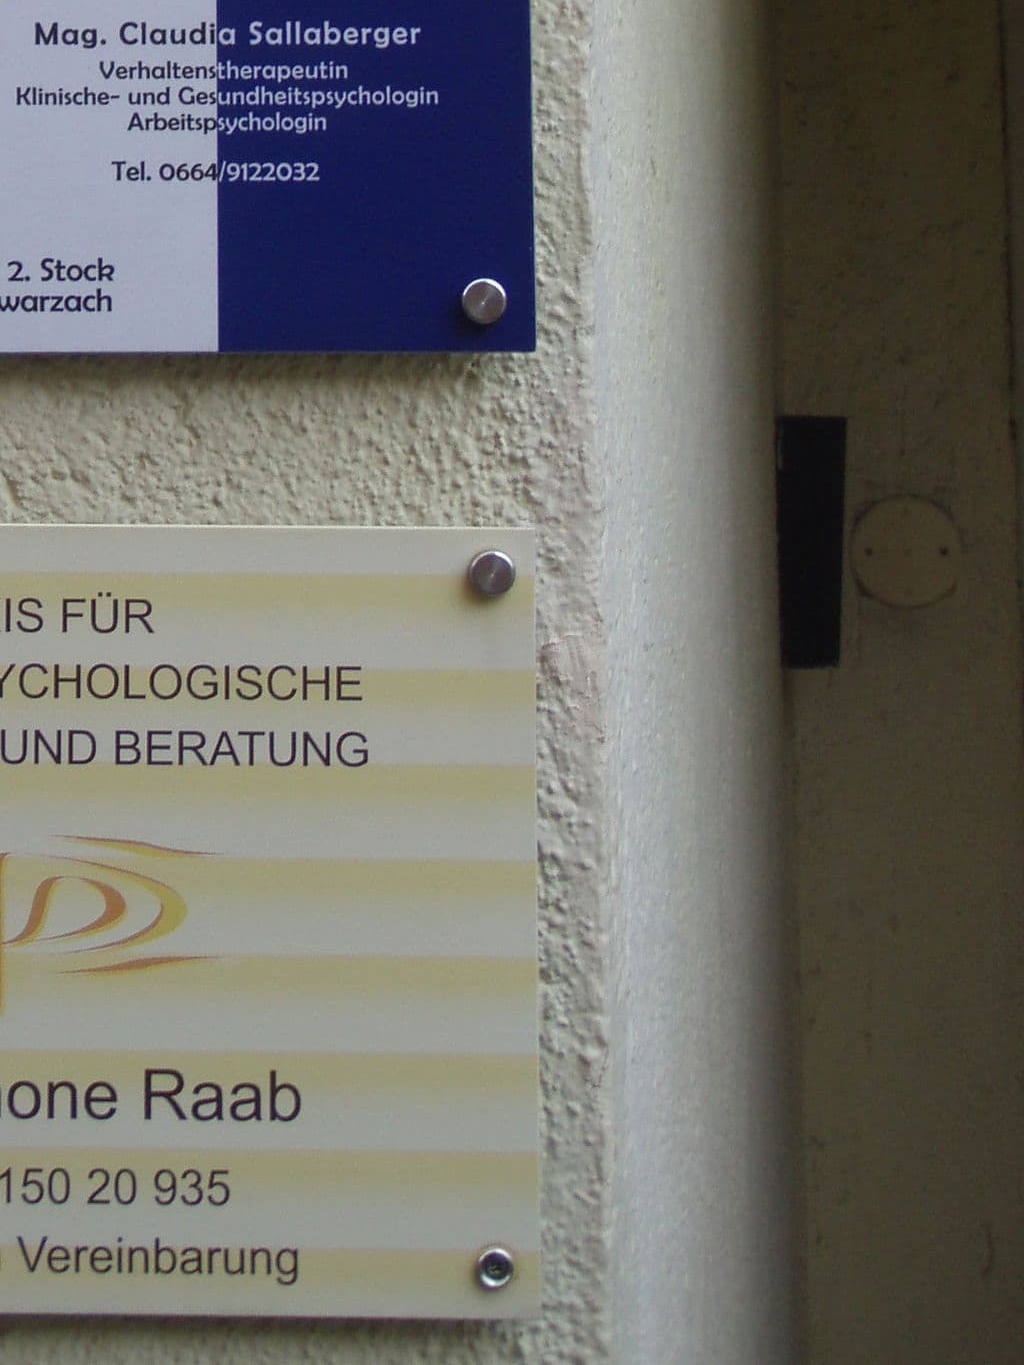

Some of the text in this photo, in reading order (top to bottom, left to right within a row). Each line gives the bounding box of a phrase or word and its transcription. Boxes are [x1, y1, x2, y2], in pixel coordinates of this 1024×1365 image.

[35, 21, 420, 48] Mag. Claudia Sallaberger
[100, 61, 347, 83] Verhaltenstherapeutin
[17, 86, 438, 108] Klinische- und Gesundheitspsychologin
[128, 112, 326, 134] Arbeitspsychologin
[112, 161, 319, 182] Tel. 0664/9122032
[8, 261, 30, 281] 2.
[41, 258, 114, 281] Stock
[62, 592, 154, 633] FÜR
[1, 729, 96, 764] UND
[116, 730, 368, 767] BERATUNG
[145, 1069, 301, 1122] Raab
[87, 1169, 136, 1205] 20
[154, 1169, 230, 1206] 935
[17, 1236, 298, 1285] Vereinbarung
